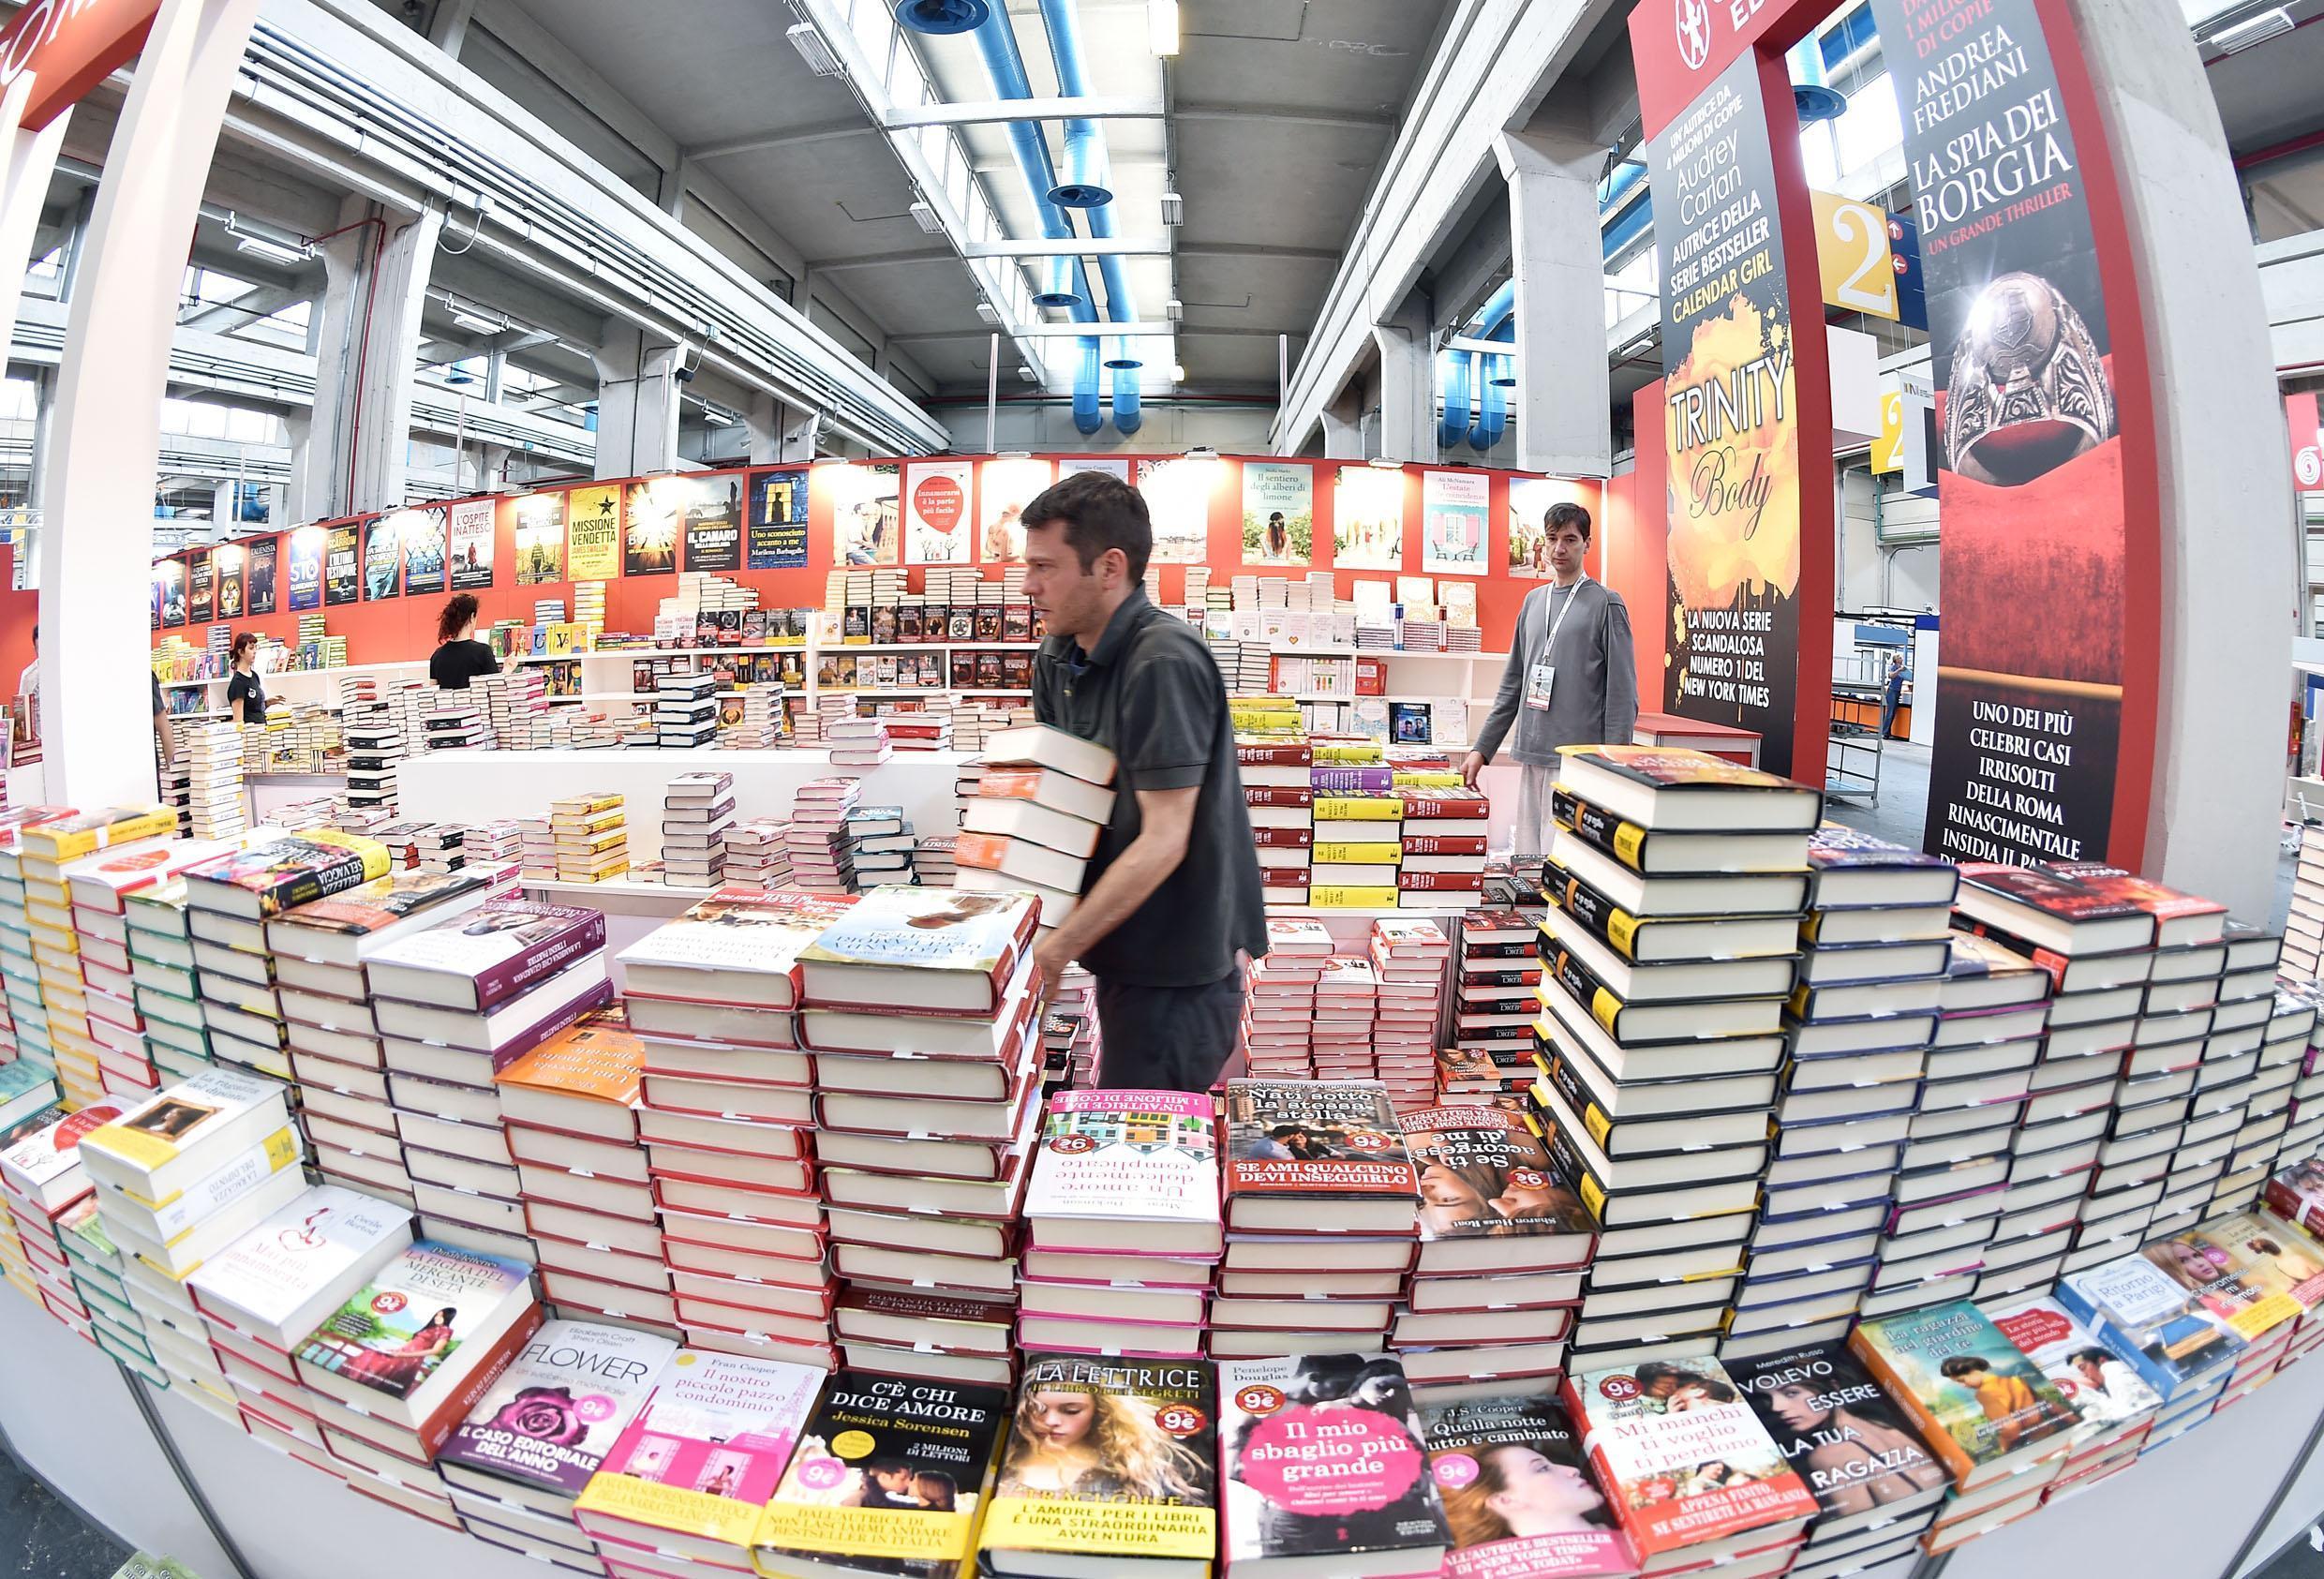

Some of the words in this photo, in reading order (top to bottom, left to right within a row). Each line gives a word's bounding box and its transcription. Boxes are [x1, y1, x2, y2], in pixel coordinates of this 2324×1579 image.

[1916, 33, 1937, 59] DI
[1939, 0, 1994, 41] COPIE
[1916, 24, 2015, 104] ANDREA
[1912, 45, 2030, 135] FREDIANI
[1670, 98, 1716, 148] UN'AUTRICE
[1717, 85, 1732, 108] DA
[1672, 131, 1704, 167] MILIONI
[1714, 95, 1744, 129] COPIE
[1913, 153, 1948, 192] LA
[1945, 121, 2006, 174] SPIA
[2004, 88, 2060, 144] DEI
[1676, 128, 1737, 199] Audrey
[1680, 165, 1741, 225] Carlan
[1916, 132, 2073, 236] BORGIA
[1673, 216, 1720, 268] AUTRICE
[1721, 189, 1762, 233] DELLA
[1928, 237, 1947, 256] UN
[1949, 211, 2004, 246] GRANDE
[2004, 183, 2073, 222] THRILLER
[1670, 261, 1700, 296] SERIE
[1701, 216, 1770, 277] BESTSELLER
[1833, 204, 1892, 314] 2
[1673, 269, 1738, 323] CALENDAR
[1740, 248, 1773, 284] GIRL
[1670, 349, 1789, 452] TRINITY
[1690, 446, 1773, 541] Body
[454, 523, 491, 537] INATTESO
[457, 512, 489, 525] L'OSPITE
[573, 517, 616, 533] MISSIONE
[572, 530, 617, 546] VENDETTA
[698, 529, 738, 542] CANARO
[1688, 611, 1699, 629] LA
[1702, 611, 1740, 630] NUOVA
[1743, 611, 1771, 632] SERIE
[1691, 633, 1764, 656] SCANDALOSA
[1691, 656, 1733, 678] NUMERO
[1736, 660, 1741, 678] 1
[1745, 661, 1765, 681] DEL
[1685, 677, 1706, 696] NEW
[1708, 680, 1736, 703] YORK
[1738, 684, 1769, 708] TIMES
[1973, 701, 2009, 724] UNO
[2012, 707, 2040, 730] DEI
[2044, 710, 2074, 737] PIÙ
[1970, 728, 2031, 757] CELEBRI
[2034, 740, 2072, 767] CASI
[1978, 756, 2056, 793] IRRISOLTI
[1965, 781, 2012, 811] DELLA
[2015, 793, 2064, 826] ROMA
[1948, 802, 2081, 861] RINASCIMENTALE
[318, 859, 364, 886] SELVAGGIA
[1248, 1089, 1303, 1101] Nati
[1311, 1091, 1372, 1101] sotto
[1255, 1098, 1279, 1110] la
[1288, 1099, 1365, 1110] stessa
[1276, 1110, 1348, 1120] stella
[1431, 1131, 1469, 1142] me
[1479, 1130, 1504, 1142] di
[1062, 1160, 1190, 1171] complicato
[1236, 1162, 1259, 1172] SE
[1266, 1162, 1301, 1173] AMI
[1304, 1163, 1408, 1175] QUALCUNO
[1447, 1156, 1468, 1169] ti
[1475, 1154, 1509, 1168] Se
[1055, 1171, 1194, 1185] dolcemente
[1061, 1183, 1138, 1191] amore
[1150, 1185, 1184, 1198] Un
[1240, 1172, 1287, 1183] DEVI
[1290, 1172, 1408, 1184] INSEGUIRLO
[2098, 1273, 2153, 1299] Ritorno
[1886, 1329, 1908, 1343] La
[1912, 1312, 1968, 1337] ragazza
[1894, 1341, 1919, 1356] nel
[1922, 1321, 1985, 1349] giardino
[519, 1343, 648, 1384] FLOWER
[710, 1358, 737, 1370] Fran
[739, 1362, 778, 1377] Cooper
[1035, 1363, 1065, 1382] LA
[1073, 1366, 1200, 1388] LETTRICE
[1233, 1372, 1289, 1381] Douglas
[1736, 1361, 1833, 1393] VOLEVO
[675, 1378, 734, 1394] piccolo
[737, 1388, 786, 1405] pazzo
[703, 1368, 715, 1379] Il
[719, 1373, 771, 1388] nostro
[675, 1390, 775, 1412] condominio
[871, 1380, 906, 1397] C'È
[912, 1385, 958, 1404] CHI
[1807, 1383, 1881, 1412] ESSERE
[831, 1392, 890, 1410] DICE
[894, 1400, 986, 1423] AMORE
[1477, 1404, 1524, 1414] Cooper
[831, 1409, 890, 1428] Jessica
[893, 1418, 971, 1438] Sorensen
[1284, 1422, 1307, 1439] Il
[1316, 1420, 1368, 1437] mio
[1433, 1418, 1497, 1436] Quella
[1499, 1416, 1547, 1429] notte
[1614, 1423, 1646, 1439] Mi
[1657, 1406, 1744, 1432] manchi
[458, 1425, 470, 1438] IL
[470, 1427, 514, 1446] CASO
[514, 1435, 600, 1471] EDITORIALE
[1251, 1440, 1353, 1462] sbaglio
[1361, 1436, 1408, 1458] più
[1427, 1435, 1467, 1452] utto
[1471, 1433, 1482, 1445] è
[1487, 1429, 1570, 1443] cambiato
[1640, 1437, 1659, 1451] ti
[1667, 1424, 1737, 1446] voglio
[1778, 1438, 1813, 1458] LA
[1814, 1424, 1861, 1447] TUA
[475, 1440, 559, 1473] DELL'ANNO
[1634, 1456, 1653, 1470] ti
[1661, 1437, 1759, 1467] perdono
[1282, 1458, 1385, 1482] grande
[1810, 1446, 1924, 1489] RAGAZZA
[1022, 1505, 1095, 1517] L'AMORE
[1102, 1508, 1136, 1520] PER
[1155, 1512, 1200, 1523] LIBRI
[1058, 1529, 1159, 1543] AVVENTURA
